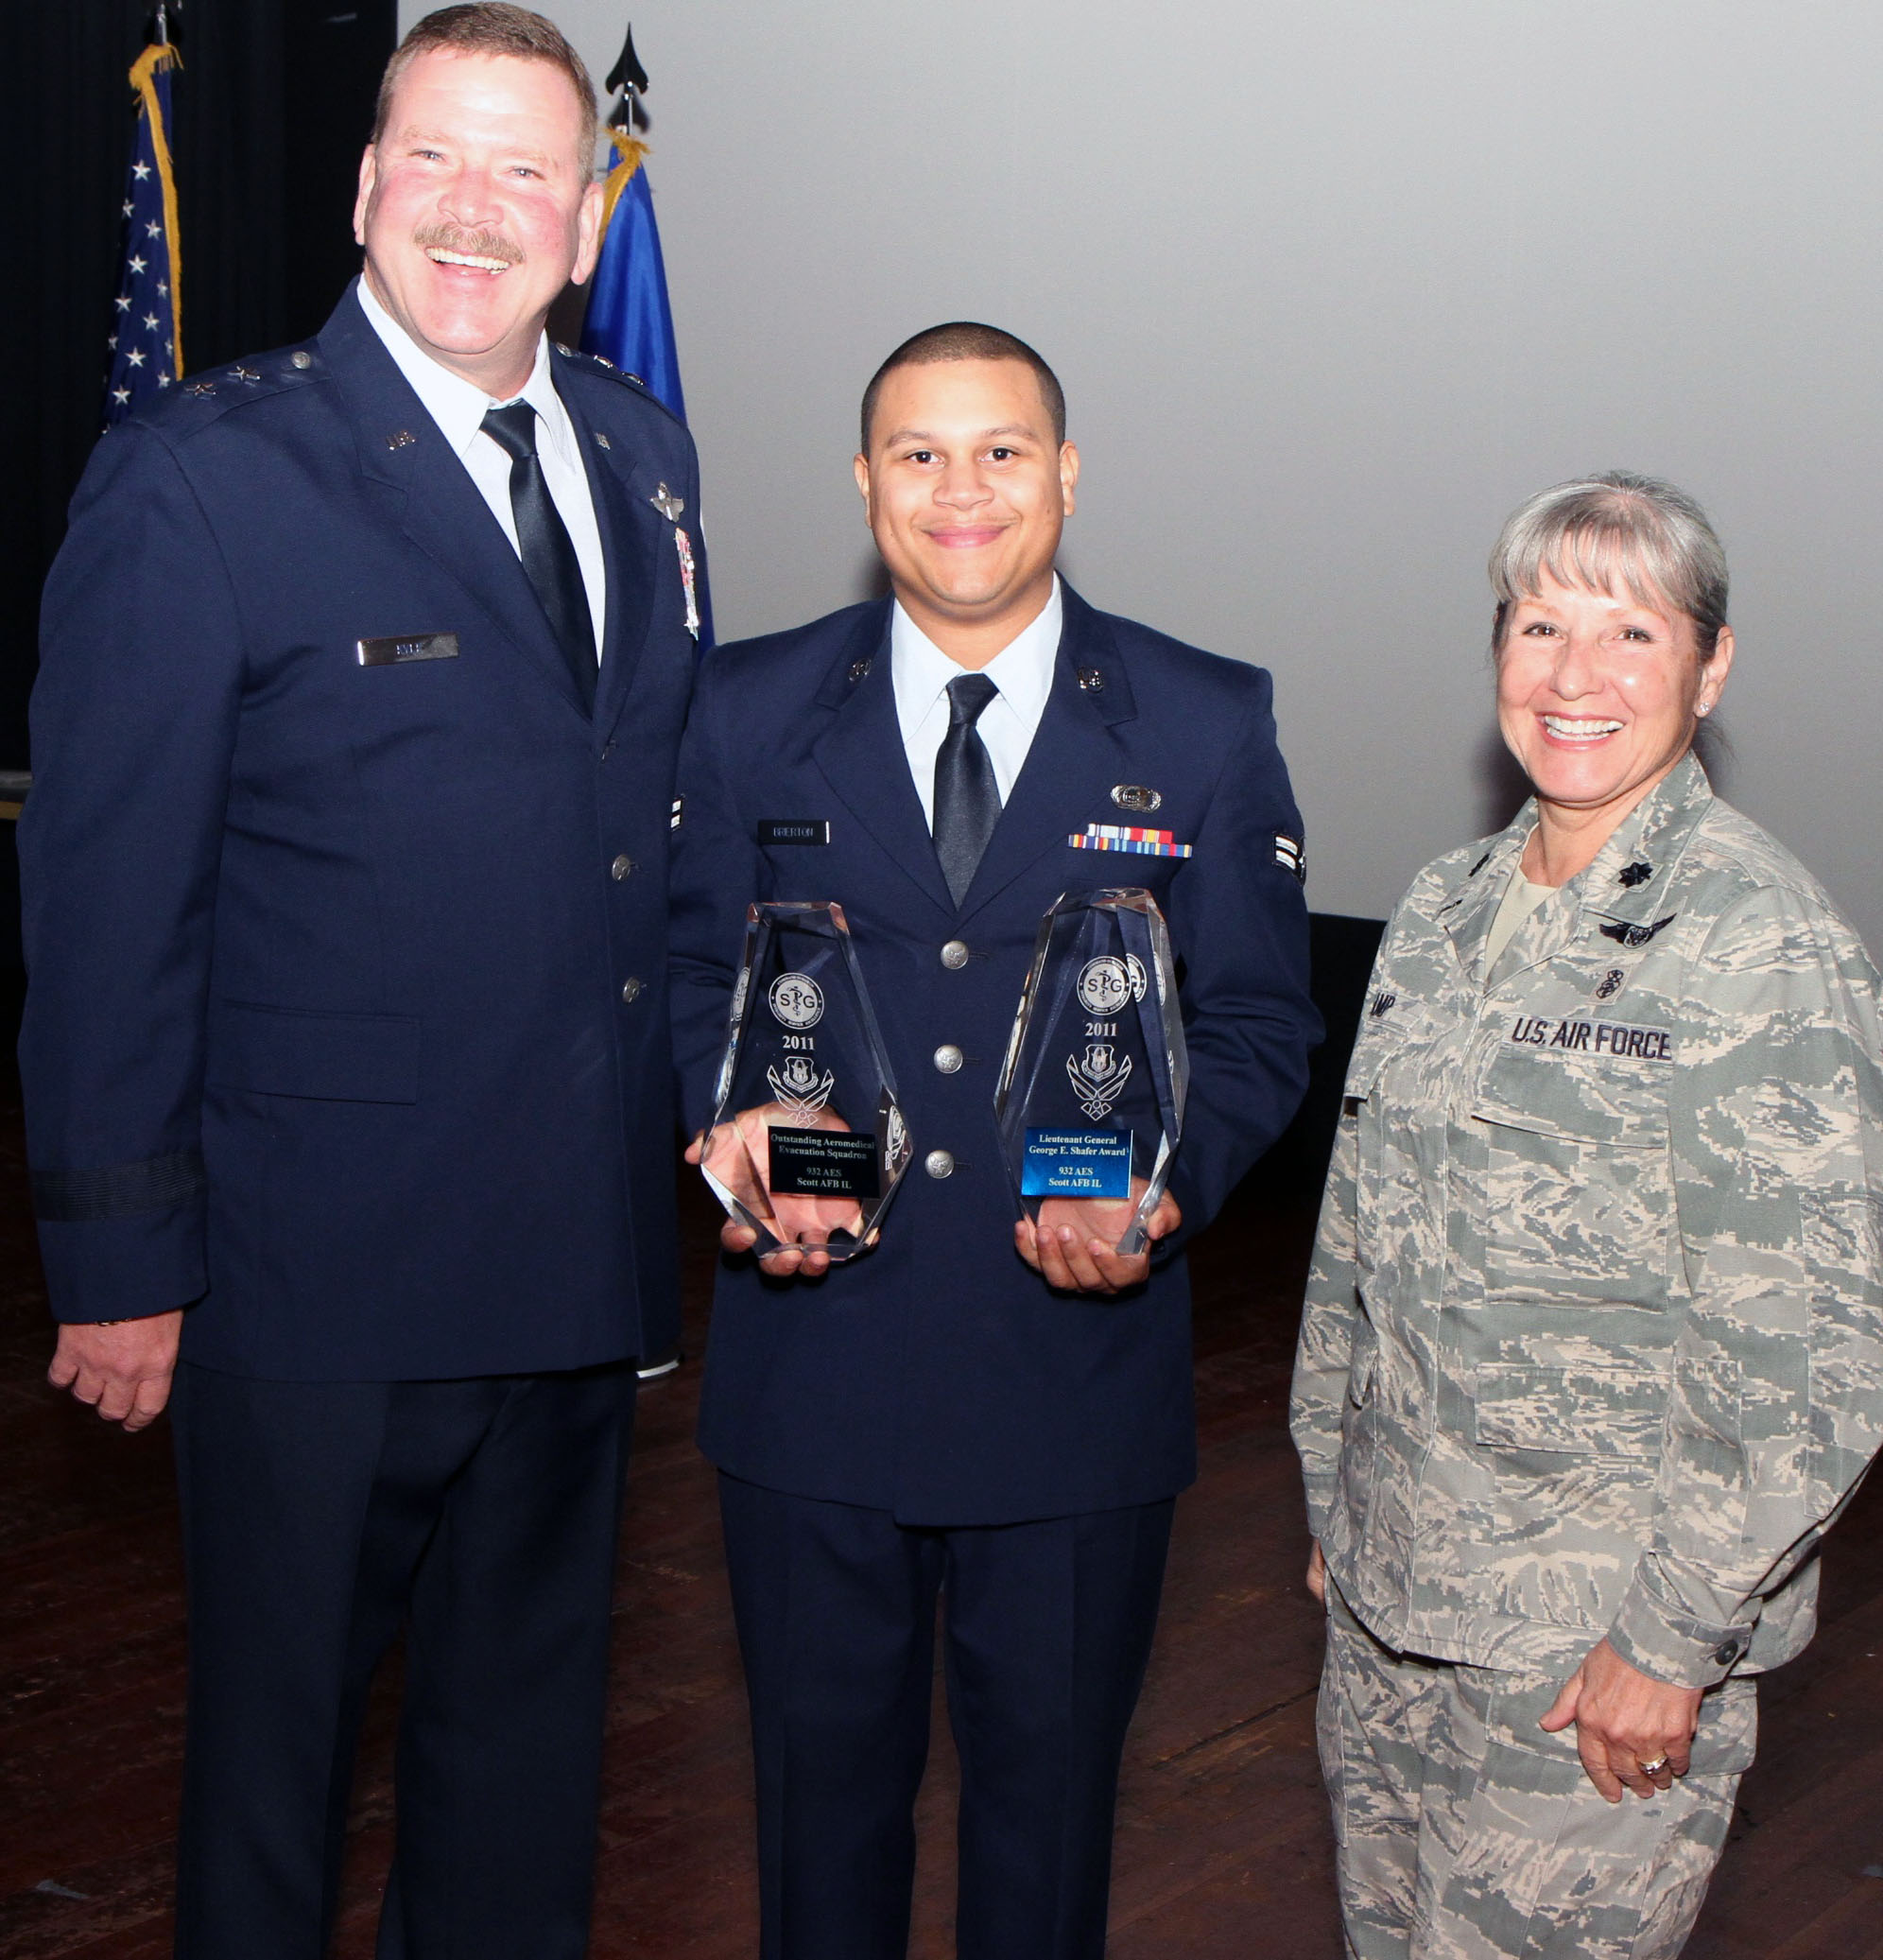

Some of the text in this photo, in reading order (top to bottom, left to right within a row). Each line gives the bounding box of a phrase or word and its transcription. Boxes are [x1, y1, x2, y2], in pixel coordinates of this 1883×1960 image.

[1084, 1022, 1117, 1036] 2011
[782, 1035, 815, 1049] 2011
[1512, 1017, 1671, 1061] U.S. AIR FORCE
[770, 1134, 875, 1150] Outstanding Aeromedical
[1039, 1135, 1117, 1144] Lieutenant General
[779, 1145, 867, 1159] Evacuation Squadron
[1028, 1145, 1126, 1156] George E. Shafer Award
[806, 1167, 841, 1177] 932 AES
[1059, 1167, 1094, 1176] 932 AES
[797, 1177, 852, 1189] Scott AFB IL
[1048, 1177, 1102, 1188] Scott AFB IL
